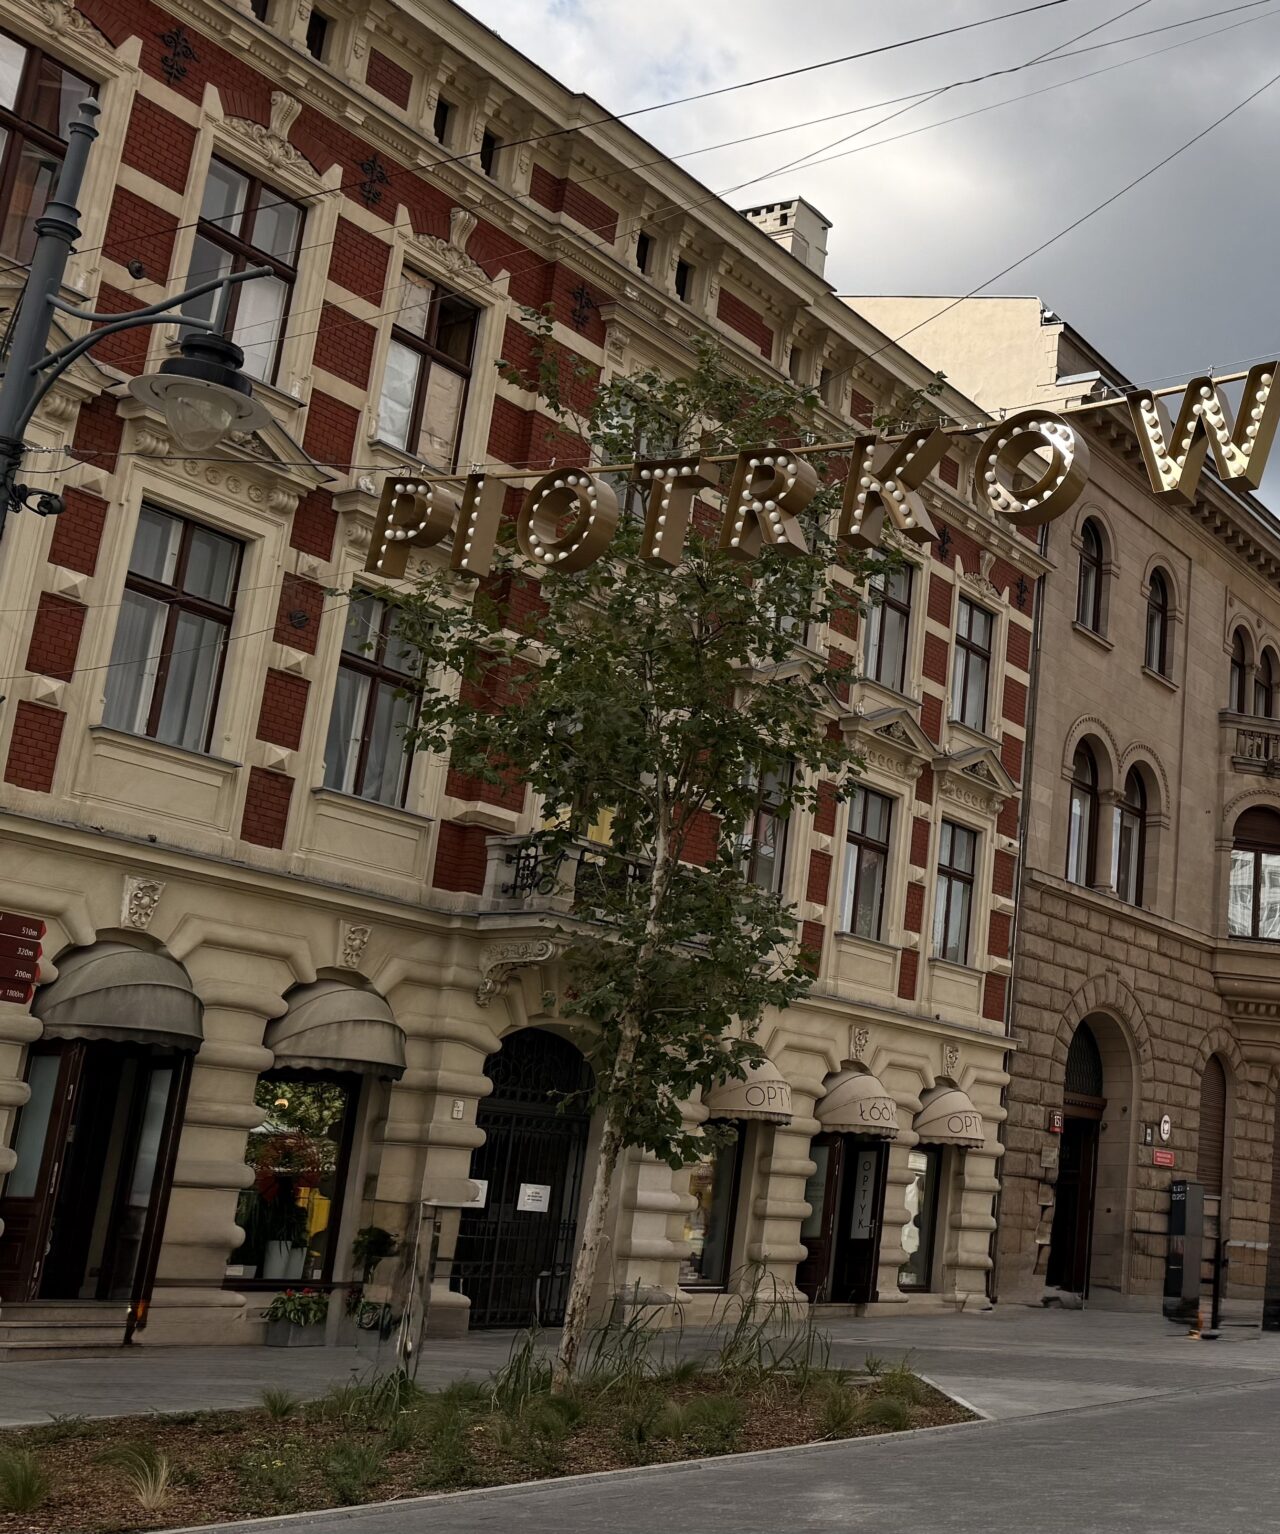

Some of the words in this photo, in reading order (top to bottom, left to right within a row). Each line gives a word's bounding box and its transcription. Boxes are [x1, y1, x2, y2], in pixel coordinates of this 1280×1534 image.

[21, 926, 38, 937] 510m
[14, 969, 32, 979] 200m
[858, 1161, 872, 1229] OPTYK
